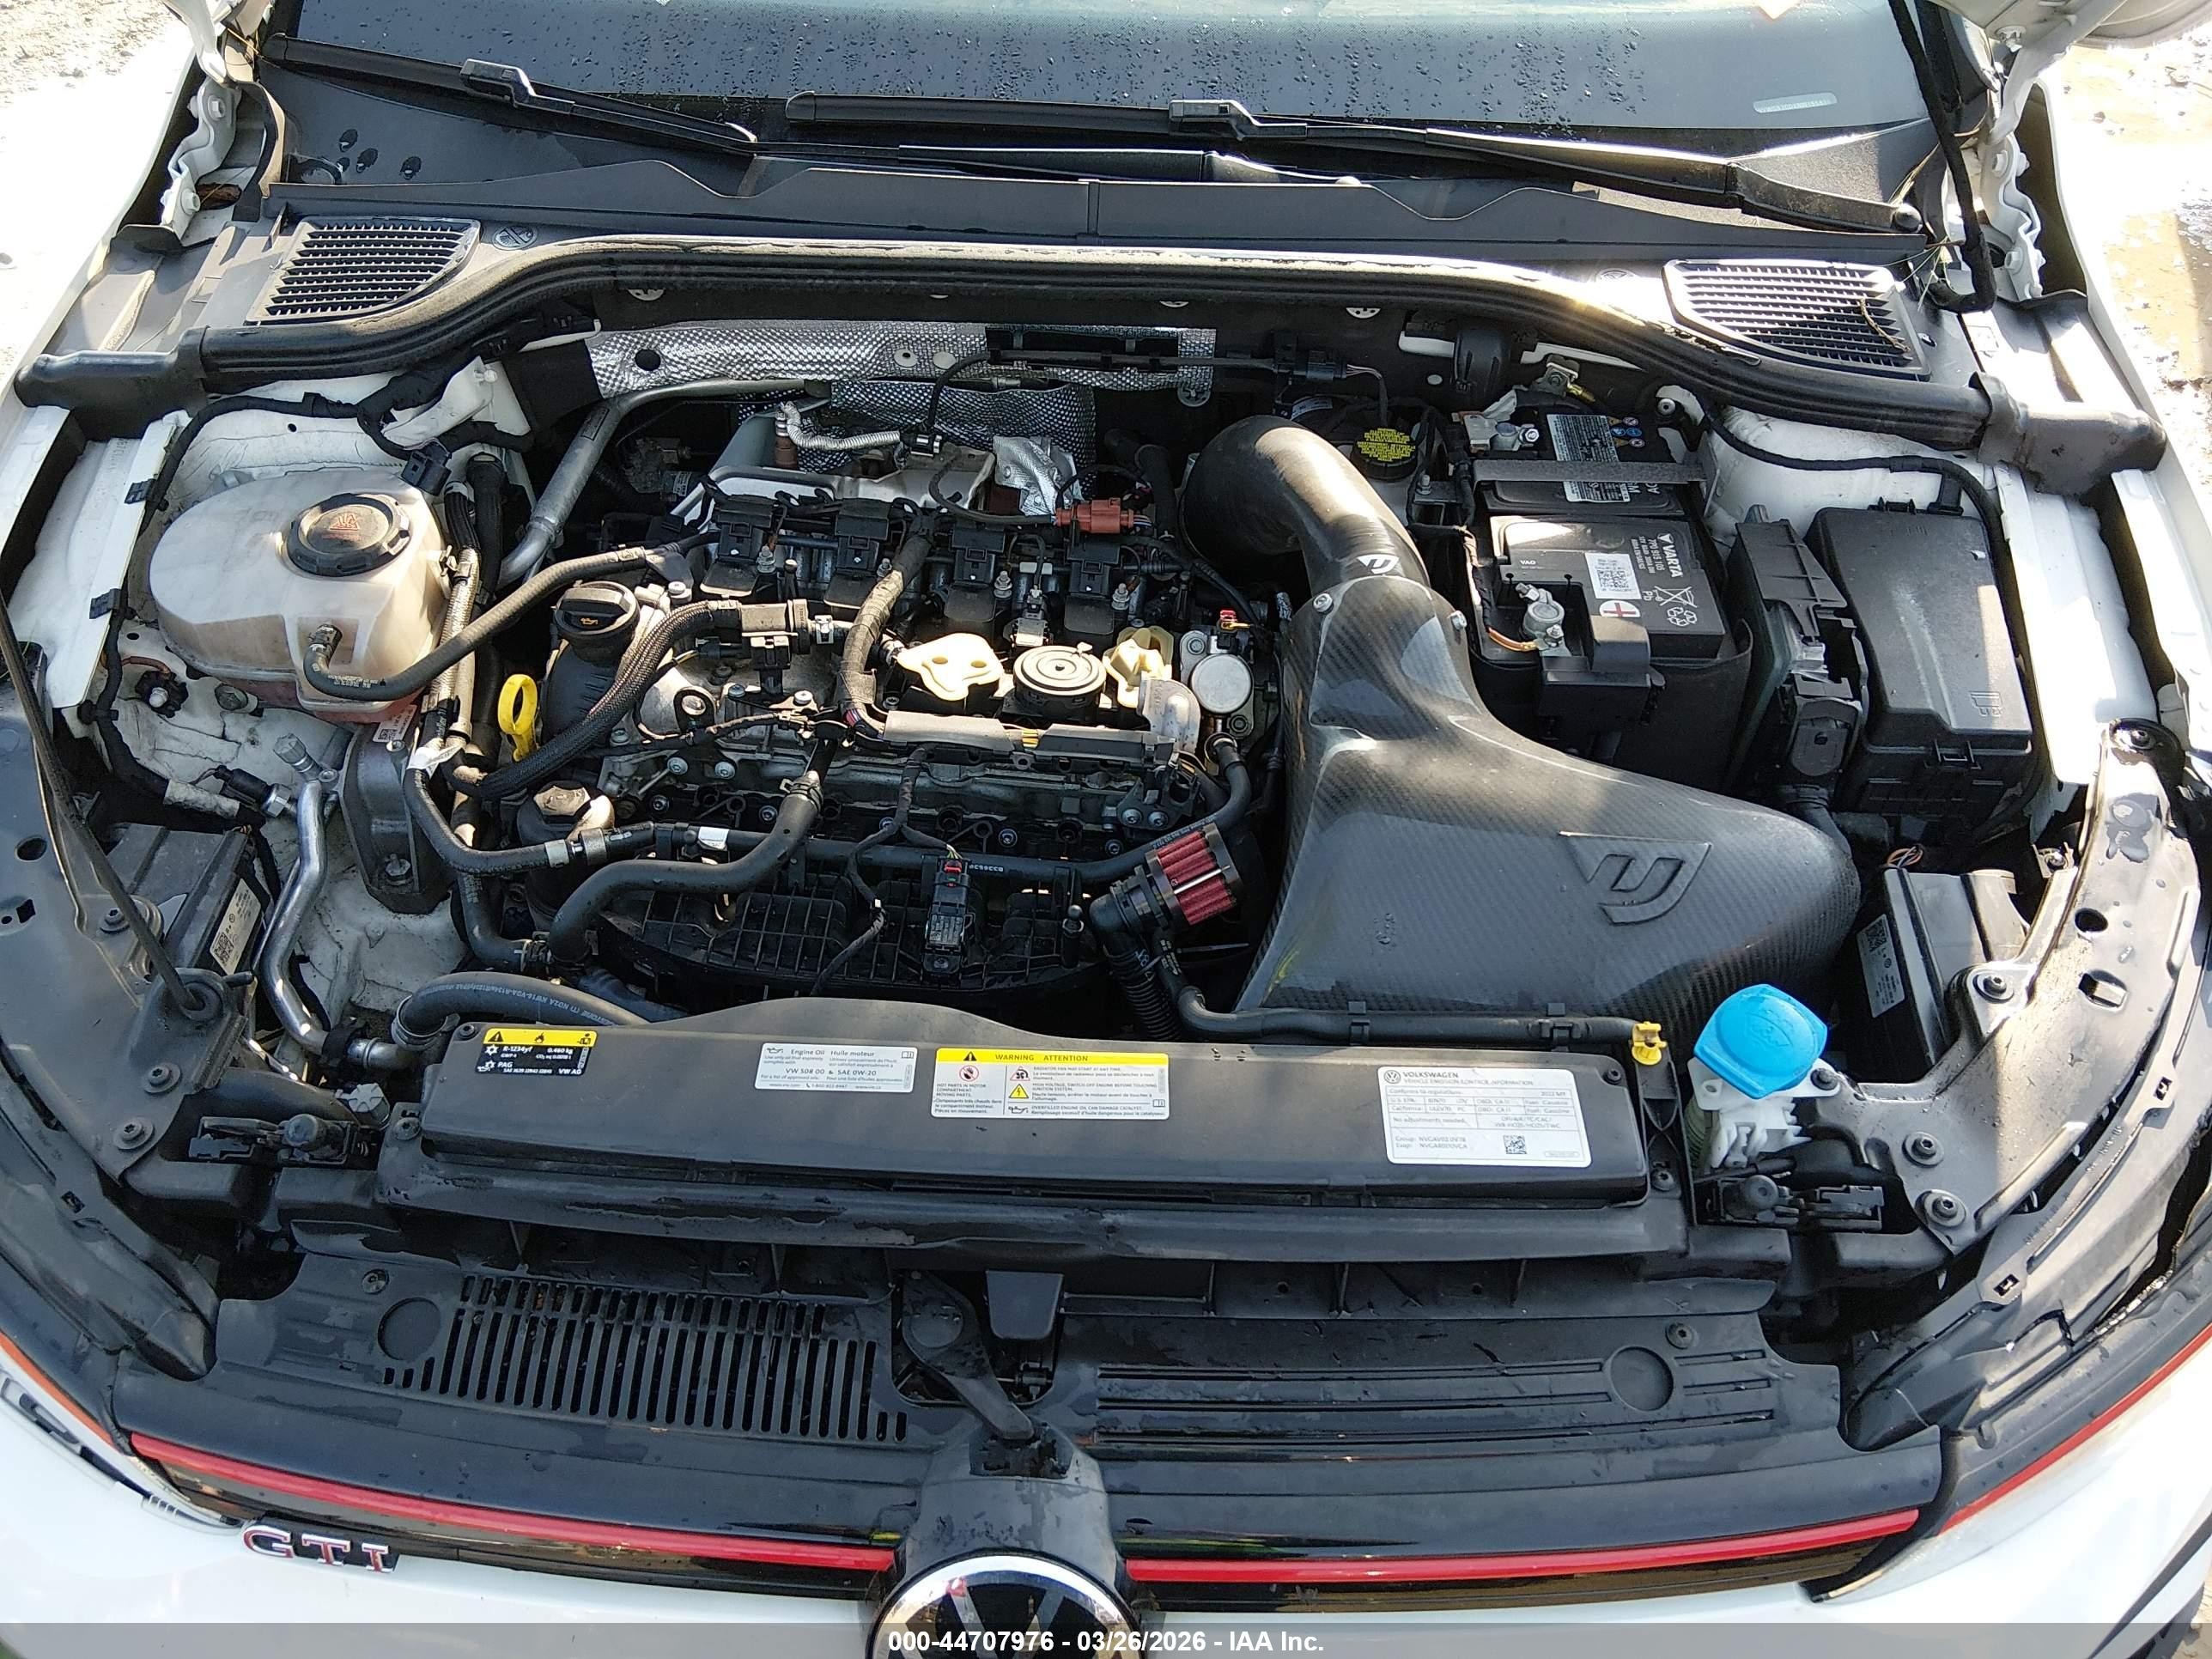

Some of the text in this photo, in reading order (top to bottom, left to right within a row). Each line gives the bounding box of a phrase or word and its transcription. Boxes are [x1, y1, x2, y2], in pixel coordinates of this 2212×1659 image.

[1663, 545, 1683, 578] VARTA
[1642, 590, 1654, 601] Pb
[243, 1525, 392, 1573] GTI
